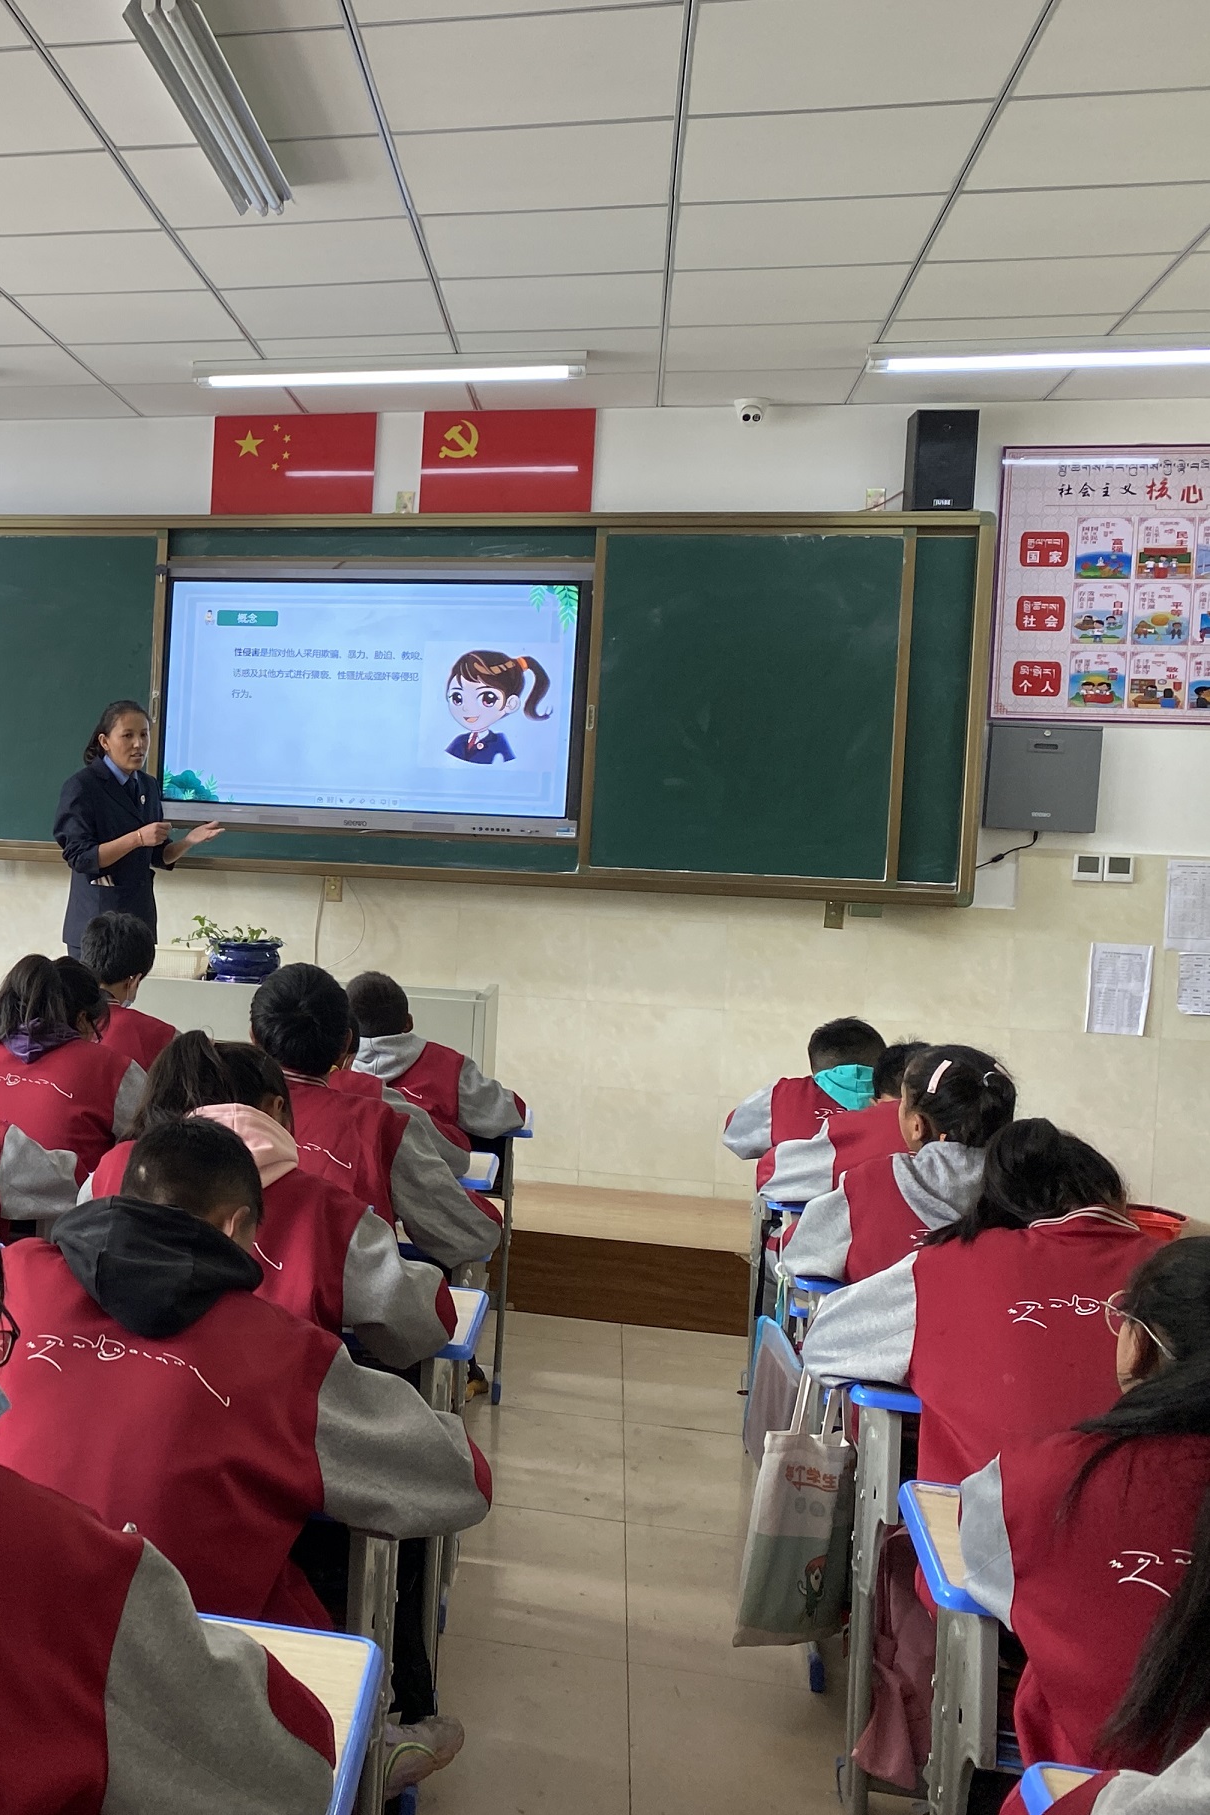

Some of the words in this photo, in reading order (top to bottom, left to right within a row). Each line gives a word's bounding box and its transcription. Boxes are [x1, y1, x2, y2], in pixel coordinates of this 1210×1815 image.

[1026, 550, 1063, 564] 国家
[236, 612, 258, 624] 概念
[1022, 615, 1059, 628] 社会
[1019, 680, 1055, 693] 个人
[231, 689, 253, 699] 行为。
